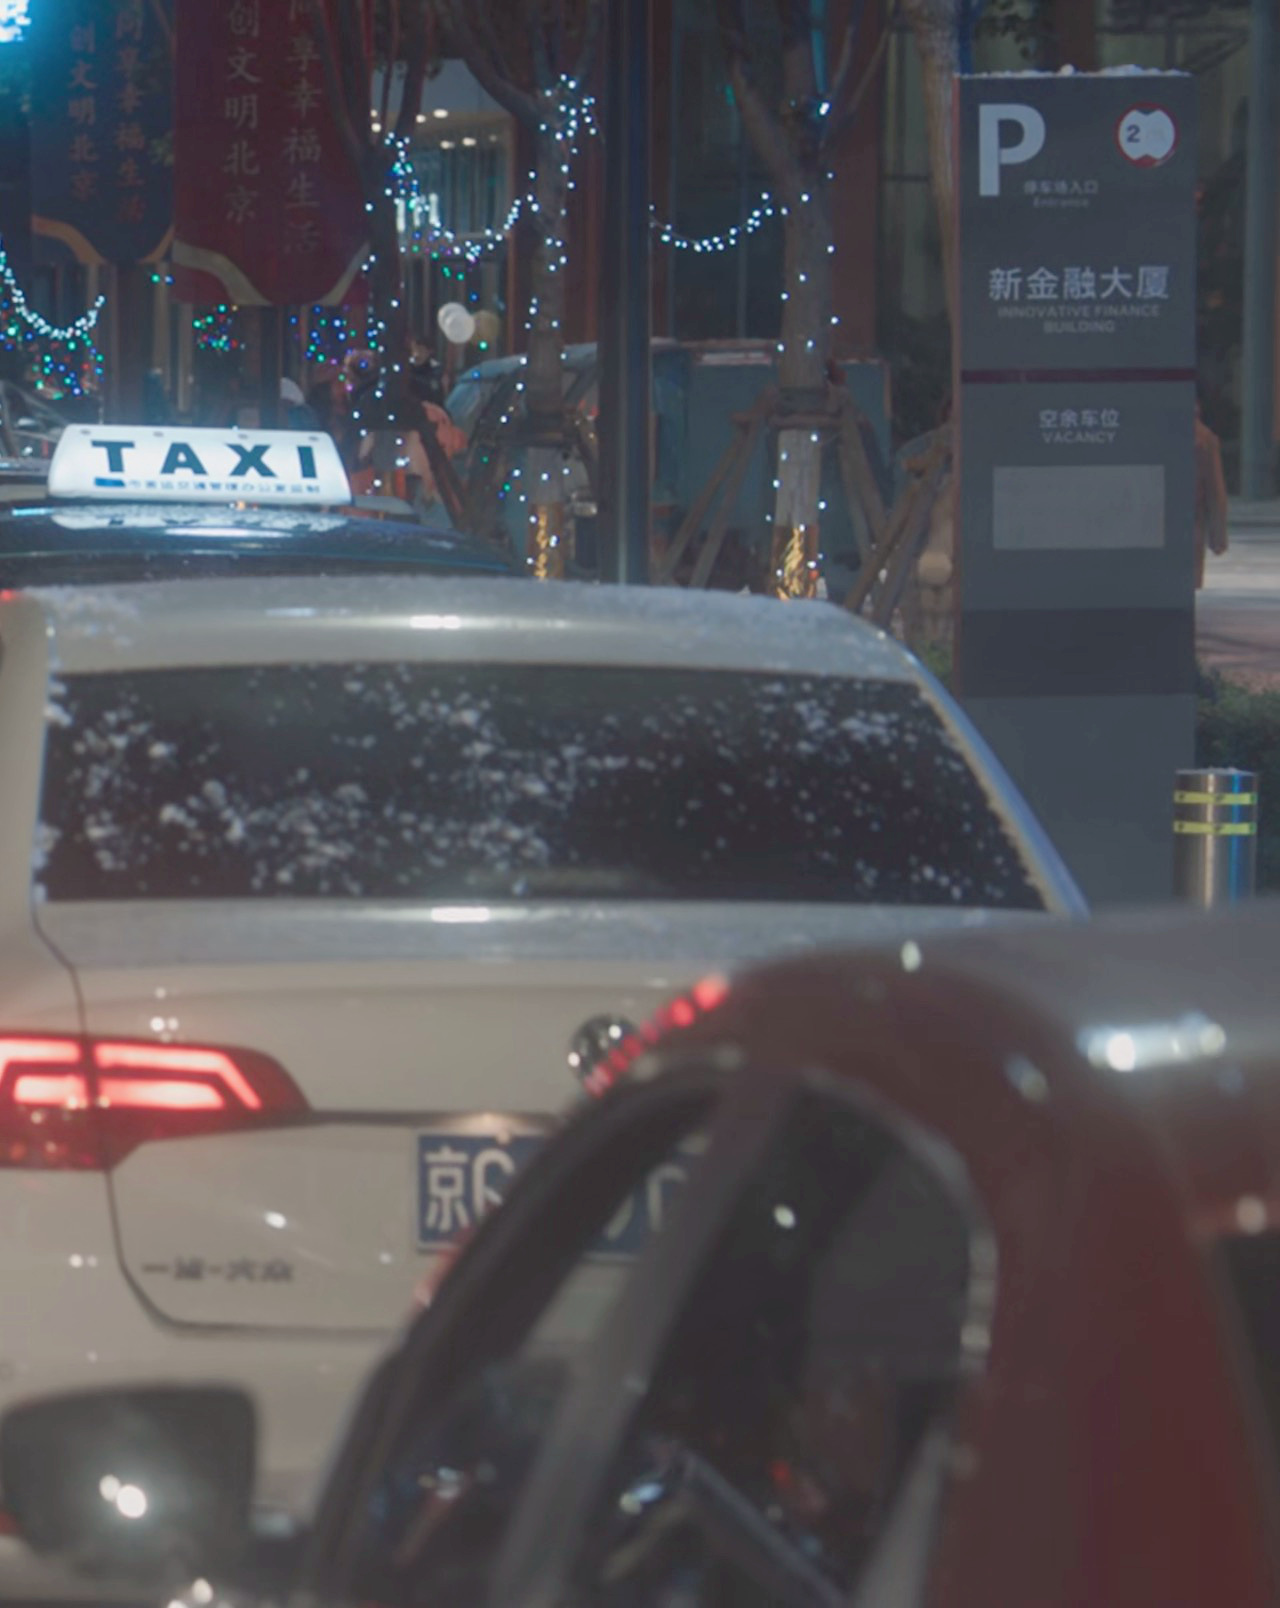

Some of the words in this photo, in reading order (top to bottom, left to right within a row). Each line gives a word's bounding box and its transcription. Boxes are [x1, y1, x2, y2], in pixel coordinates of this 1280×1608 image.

[978, 103, 1046, 197] P
[988, 265, 1170, 301] 新金融大厦
[997, 306, 1090, 319] INNOVATIVE
[1094, 304, 1161, 317] FINANCE
[1043, 320, 1116, 334] BUILDING
[1039, 408, 1120, 428] 空余车位
[1041, 431, 1117, 444] VACANCY
[90, 440, 318, 479] TAXI
